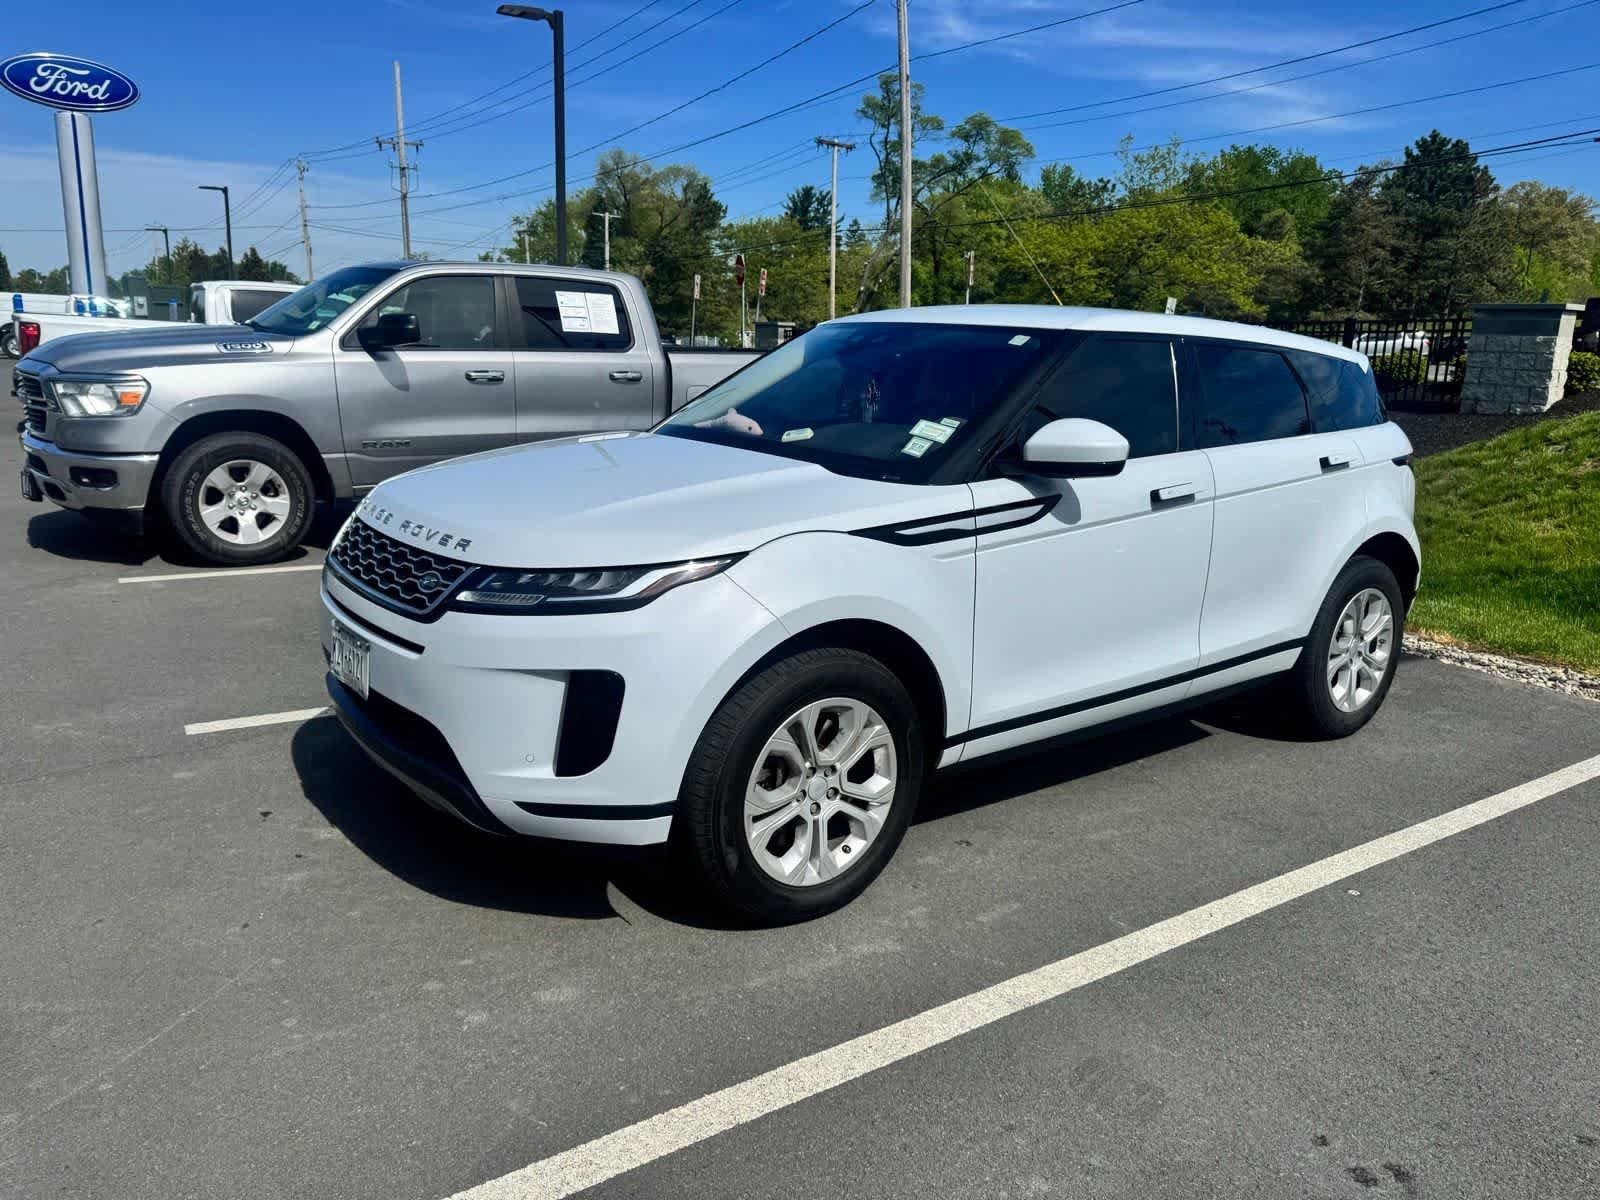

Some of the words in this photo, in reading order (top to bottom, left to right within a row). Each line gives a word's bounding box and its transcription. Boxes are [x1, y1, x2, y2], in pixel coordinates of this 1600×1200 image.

[29, 63, 111, 100] Ford
[361, 440, 411, 449] RAM
[399, 519, 473, 553] ROVER
